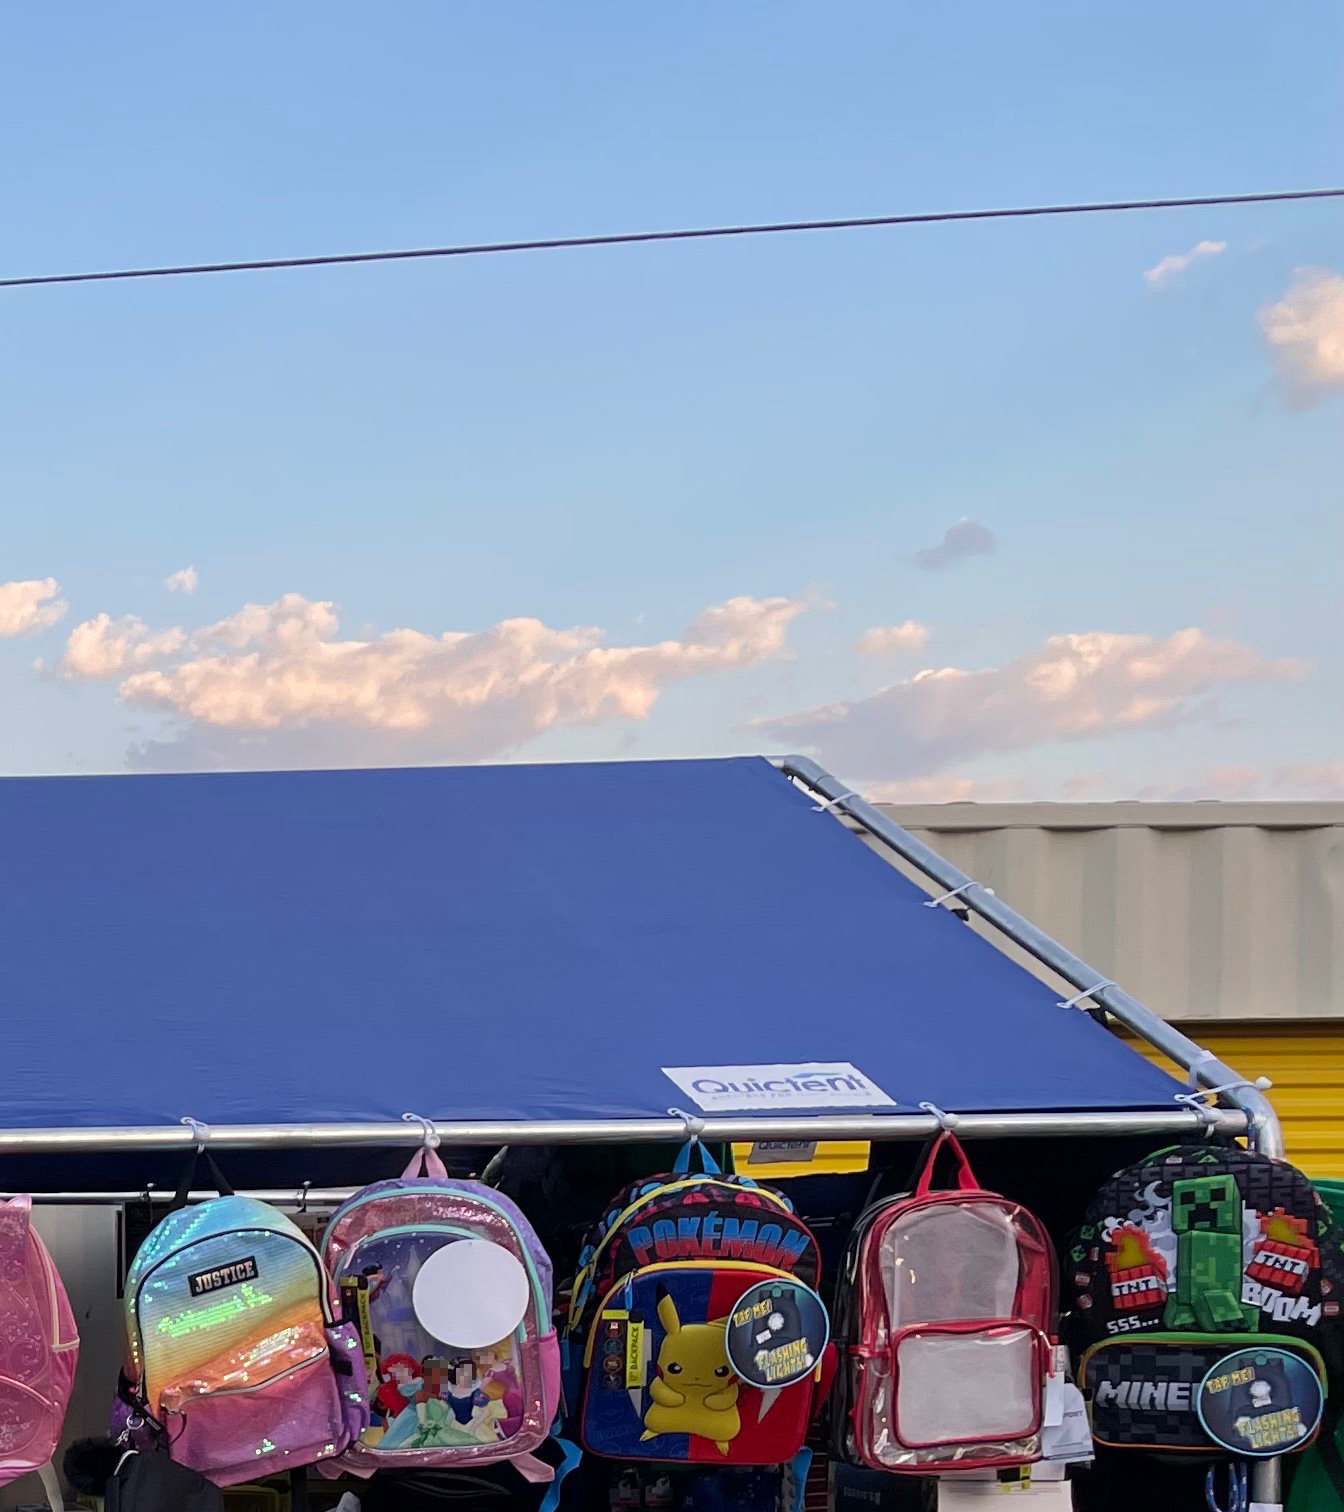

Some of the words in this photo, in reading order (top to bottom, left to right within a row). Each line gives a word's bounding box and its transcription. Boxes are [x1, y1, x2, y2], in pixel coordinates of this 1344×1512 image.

[692, 1074, 866, 1094] Quictent
[627, 1211, 811, 1270] POKÉMON
[196, 1261, 255, 1293] JUSTICE
[1263, 1253, 1301, 1271] TNT
[1116, 1278, 1152, 1295] TNT
[1242, 1283, 1322, 1326] BOOM
[1095, 1380, 1197, 1411] MINE
